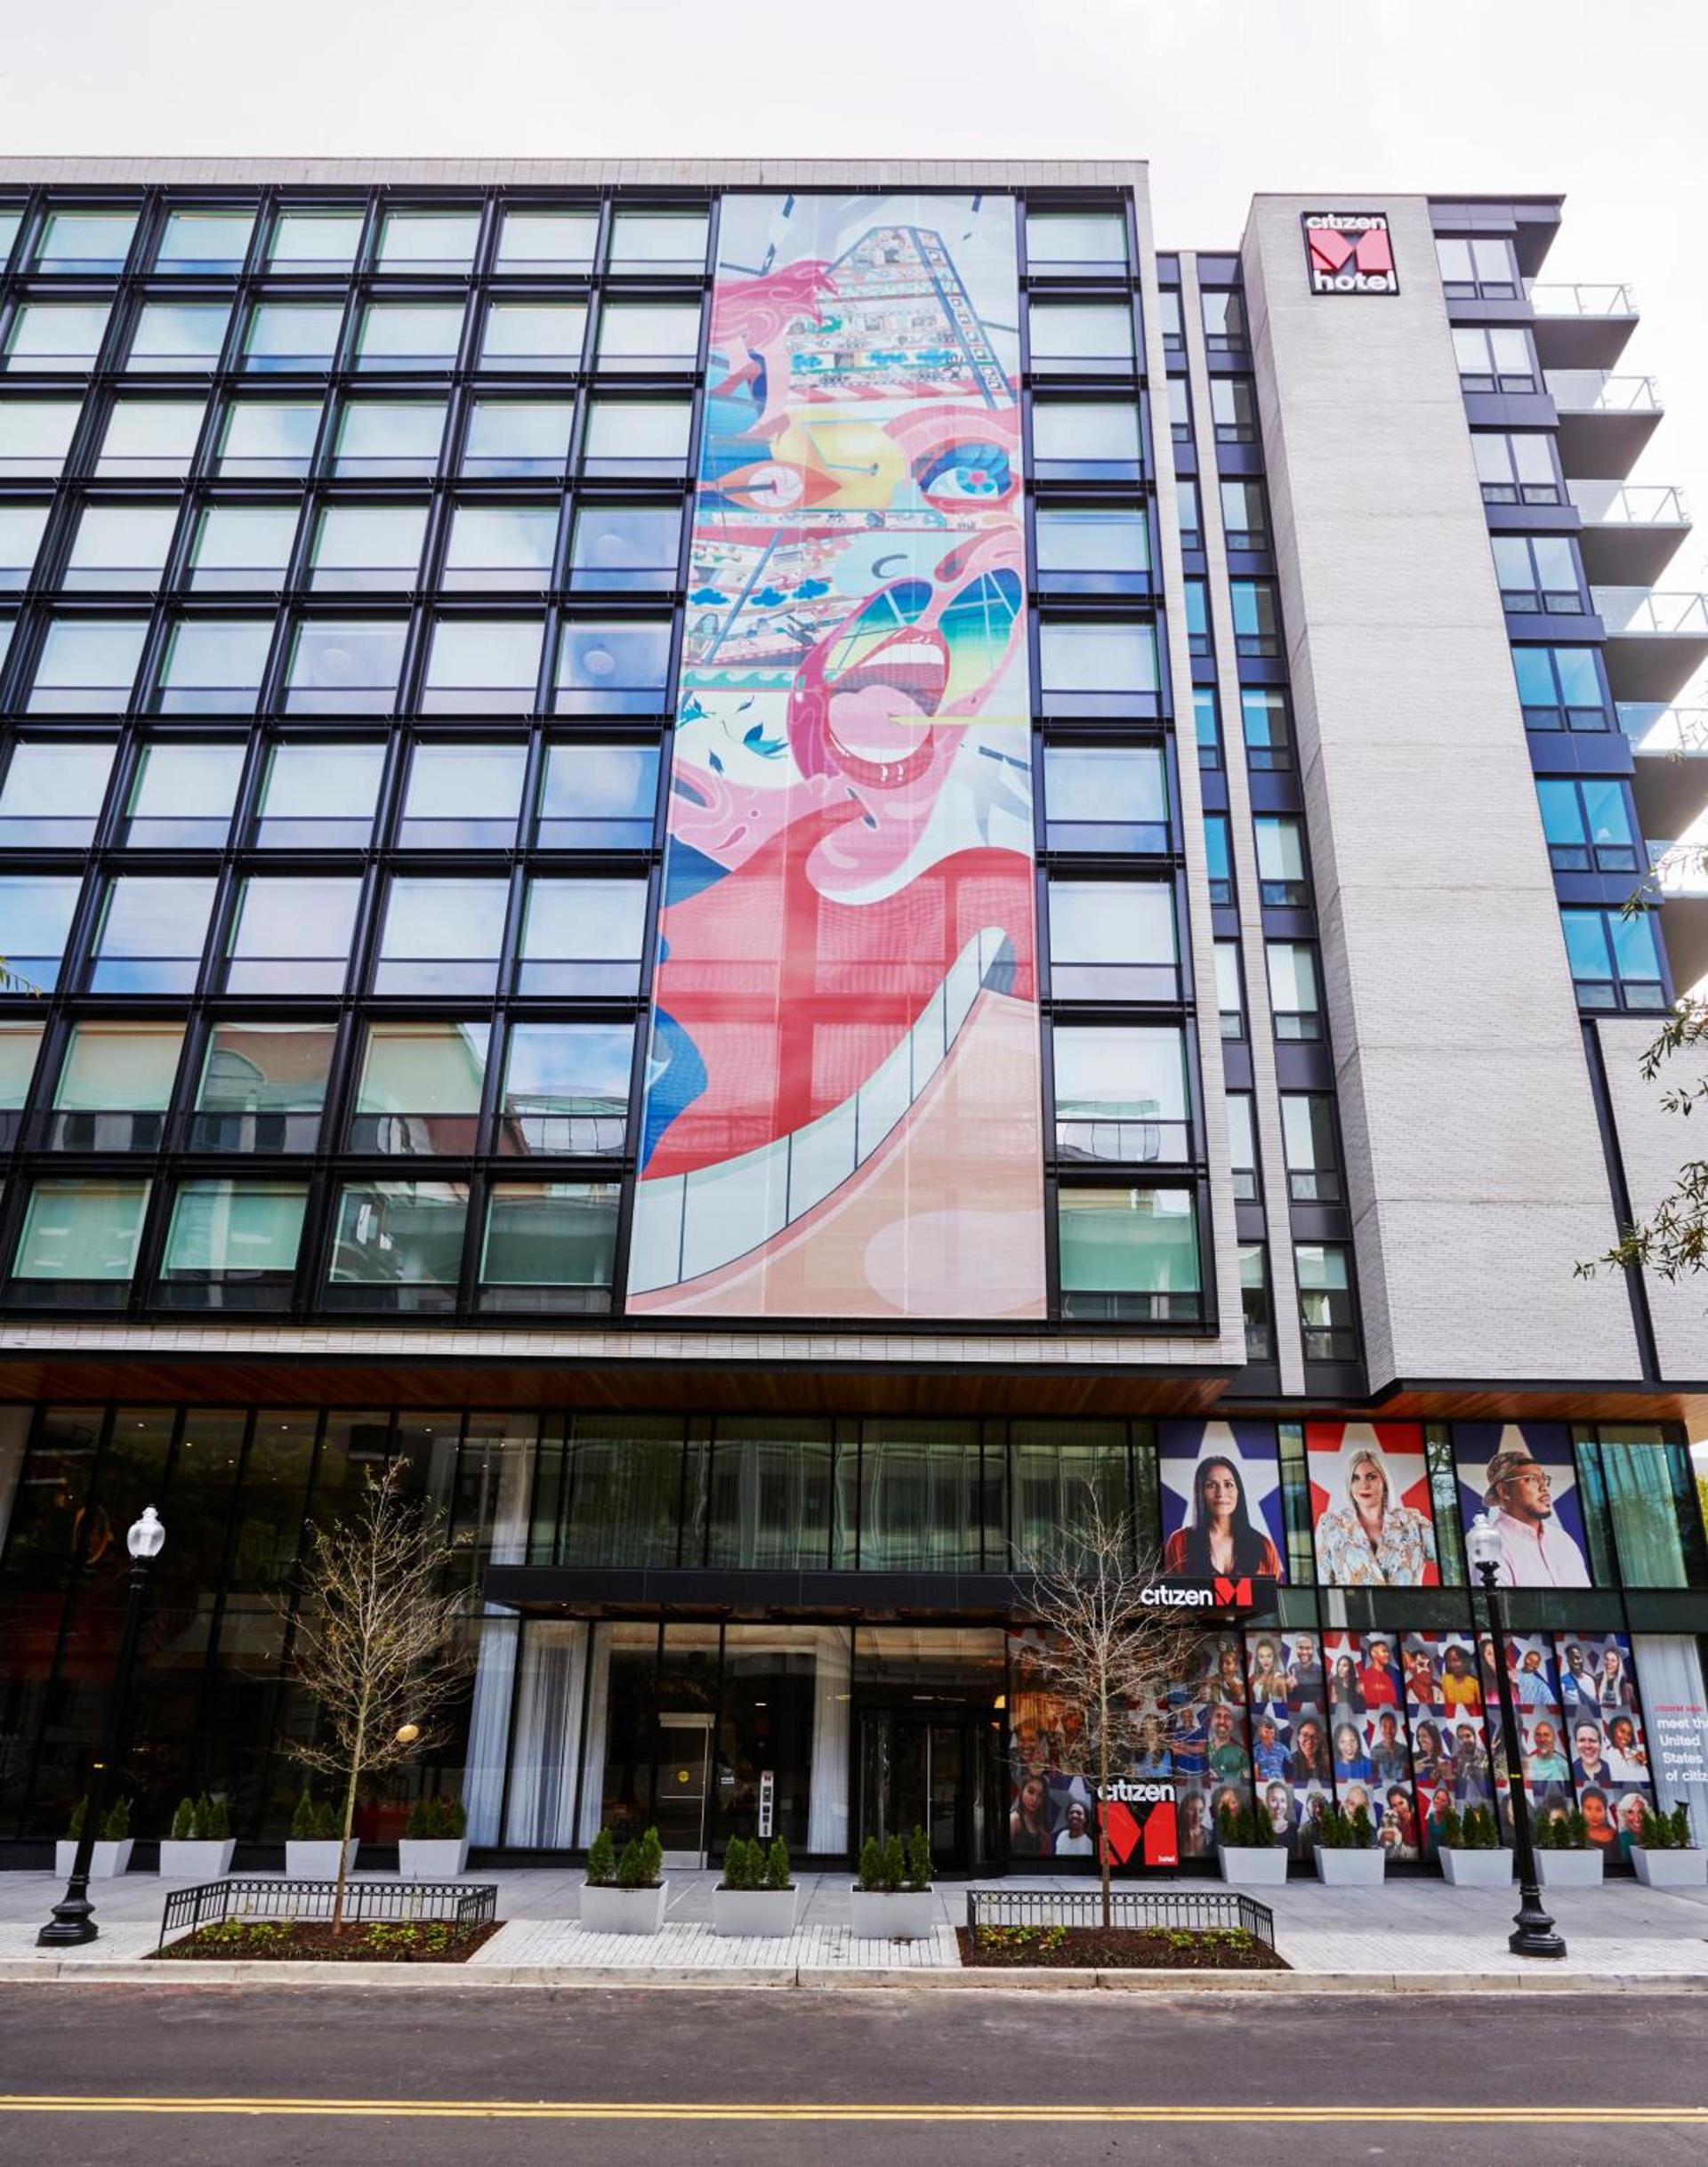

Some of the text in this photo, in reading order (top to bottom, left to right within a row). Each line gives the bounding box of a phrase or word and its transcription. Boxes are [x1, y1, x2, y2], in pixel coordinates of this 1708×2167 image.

[1306, 214, 1387, 230] citizen
[1313, 270, 1398, 291] hotel
[1656, 1718, 1690, 1729] meet
[1659, 1734, 1701, 1746] United
[1662, 1752, 1704, 1764] States
[1665, 1769, 1678, 1781] of
[1097, 1779, 1175, 1801] citizen
